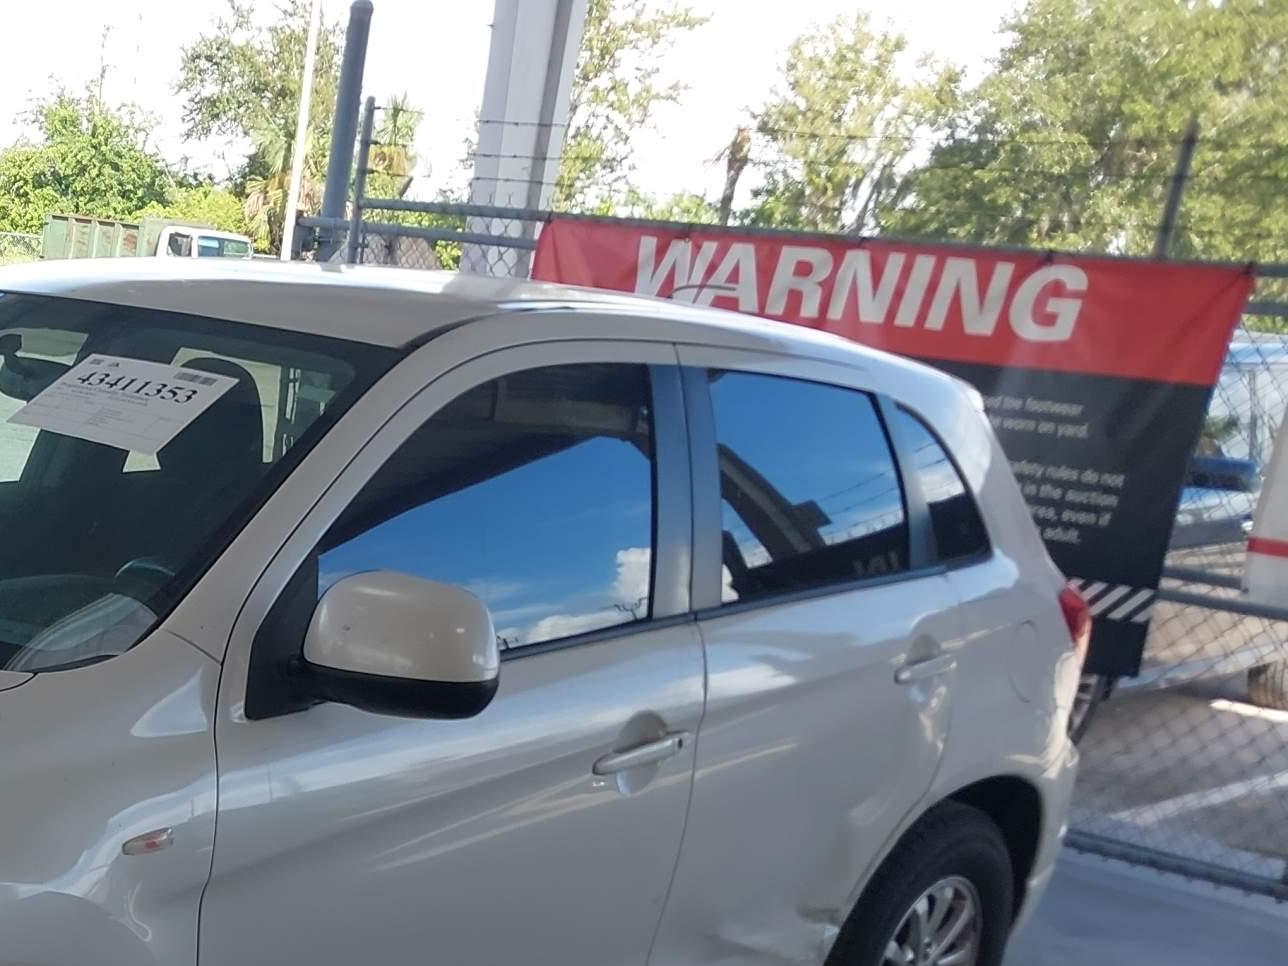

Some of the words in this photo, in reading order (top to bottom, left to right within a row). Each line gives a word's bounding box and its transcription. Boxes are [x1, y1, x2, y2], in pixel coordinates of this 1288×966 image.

[632, 235, 1089, 342] WARNING
[77, 370, 198, 404] 43411353
[1025, 398, 1085, 416] footwear
[1038, 422, 1056, 433] on
[1012, 461, 1045, 477] afety
[1046, 466, 1079, 481] rules
[1080, 471, 1099, 484] do
[1101, 474, 1125, 487] not
[1039, 485, 1063, 499] the
[1065, 490, 1118, 506] auction
[1062, 511, 1096, 525] even
